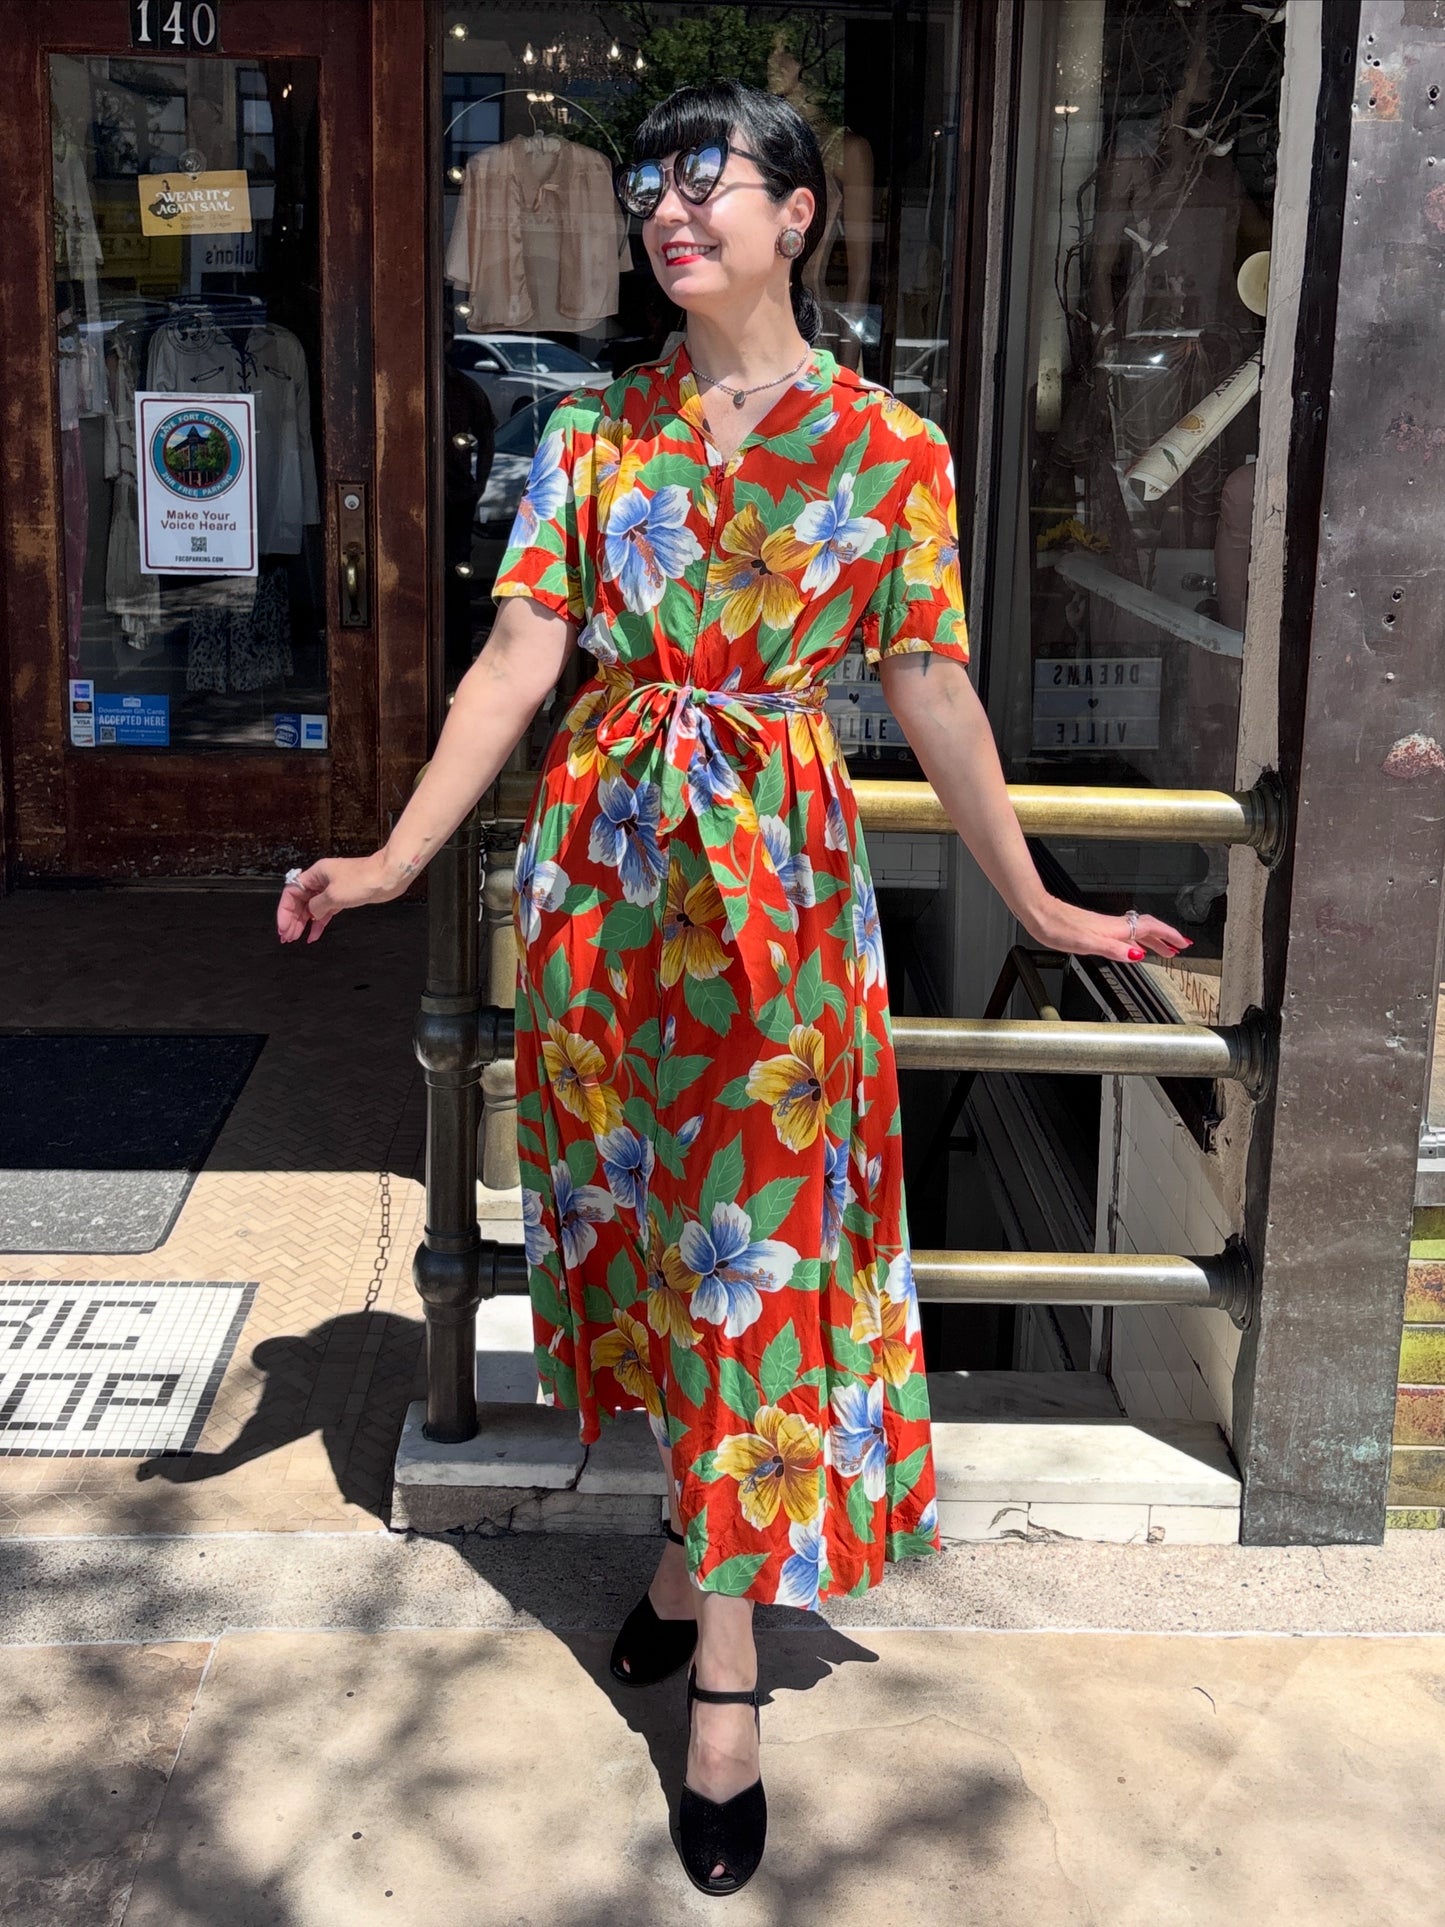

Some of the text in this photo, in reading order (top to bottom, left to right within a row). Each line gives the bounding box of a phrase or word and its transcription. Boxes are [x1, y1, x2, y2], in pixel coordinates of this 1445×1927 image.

[137, 0, 216, 46] 140
[155, 189, 221, 204] WEAR IT
[157, 202, 197, 216] AGAIN
[178, 412, 200, 425] FORT
[202, 415, 234, 441] COLLINS
[202, 473, 233, 496] PARKING
[166, 509, 231, 521] Make Your
[160, 519, 237, 532] Voice Heard
[98, 714, 166, 727] ACCEPTED HERE
[836, 717, 888, 740] ILLE
[0, 1372, 182, 1431] OP
